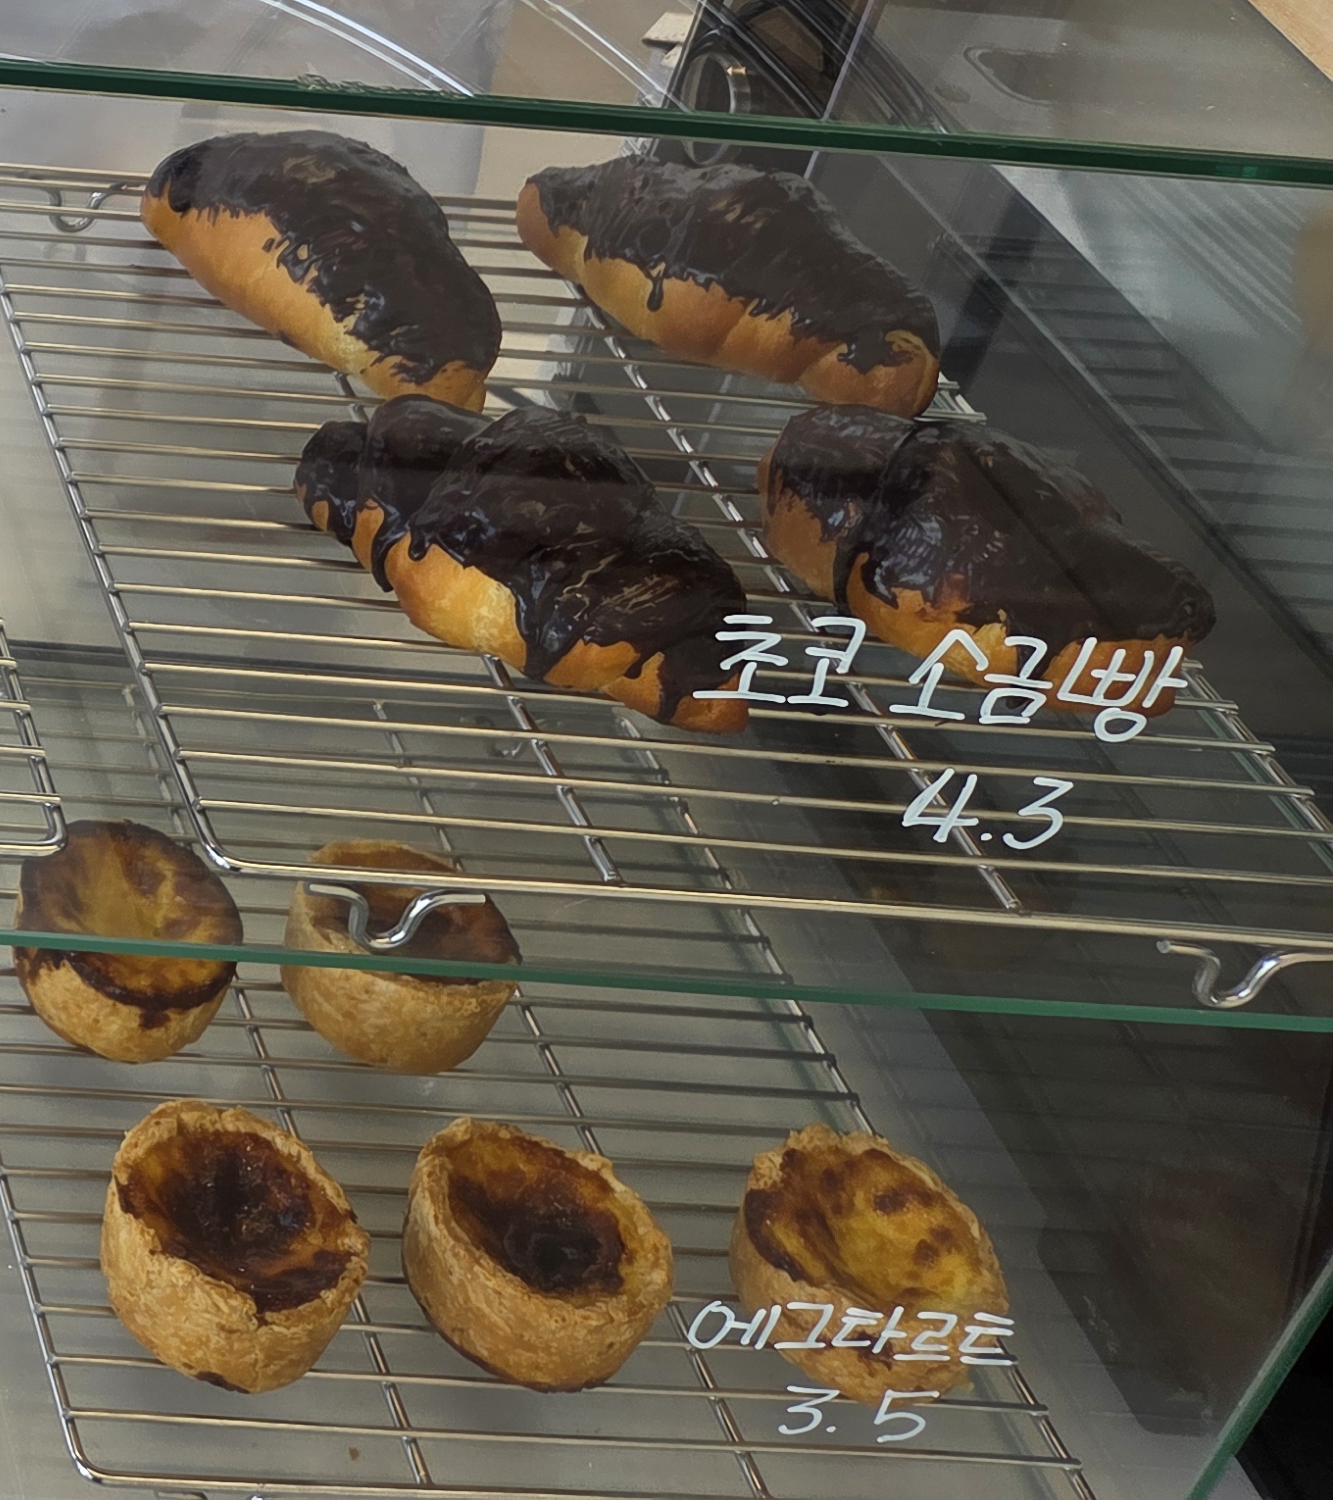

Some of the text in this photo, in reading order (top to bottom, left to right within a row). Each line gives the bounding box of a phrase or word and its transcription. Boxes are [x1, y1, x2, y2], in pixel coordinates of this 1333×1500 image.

[692, 614, 1189, 743] 초코 소금빵
[902, 768, 1075, 850] 4.3
[686, 1300, 1015, 1366] 에그타르트
[778, 1385, 941, 1443] 3.5
